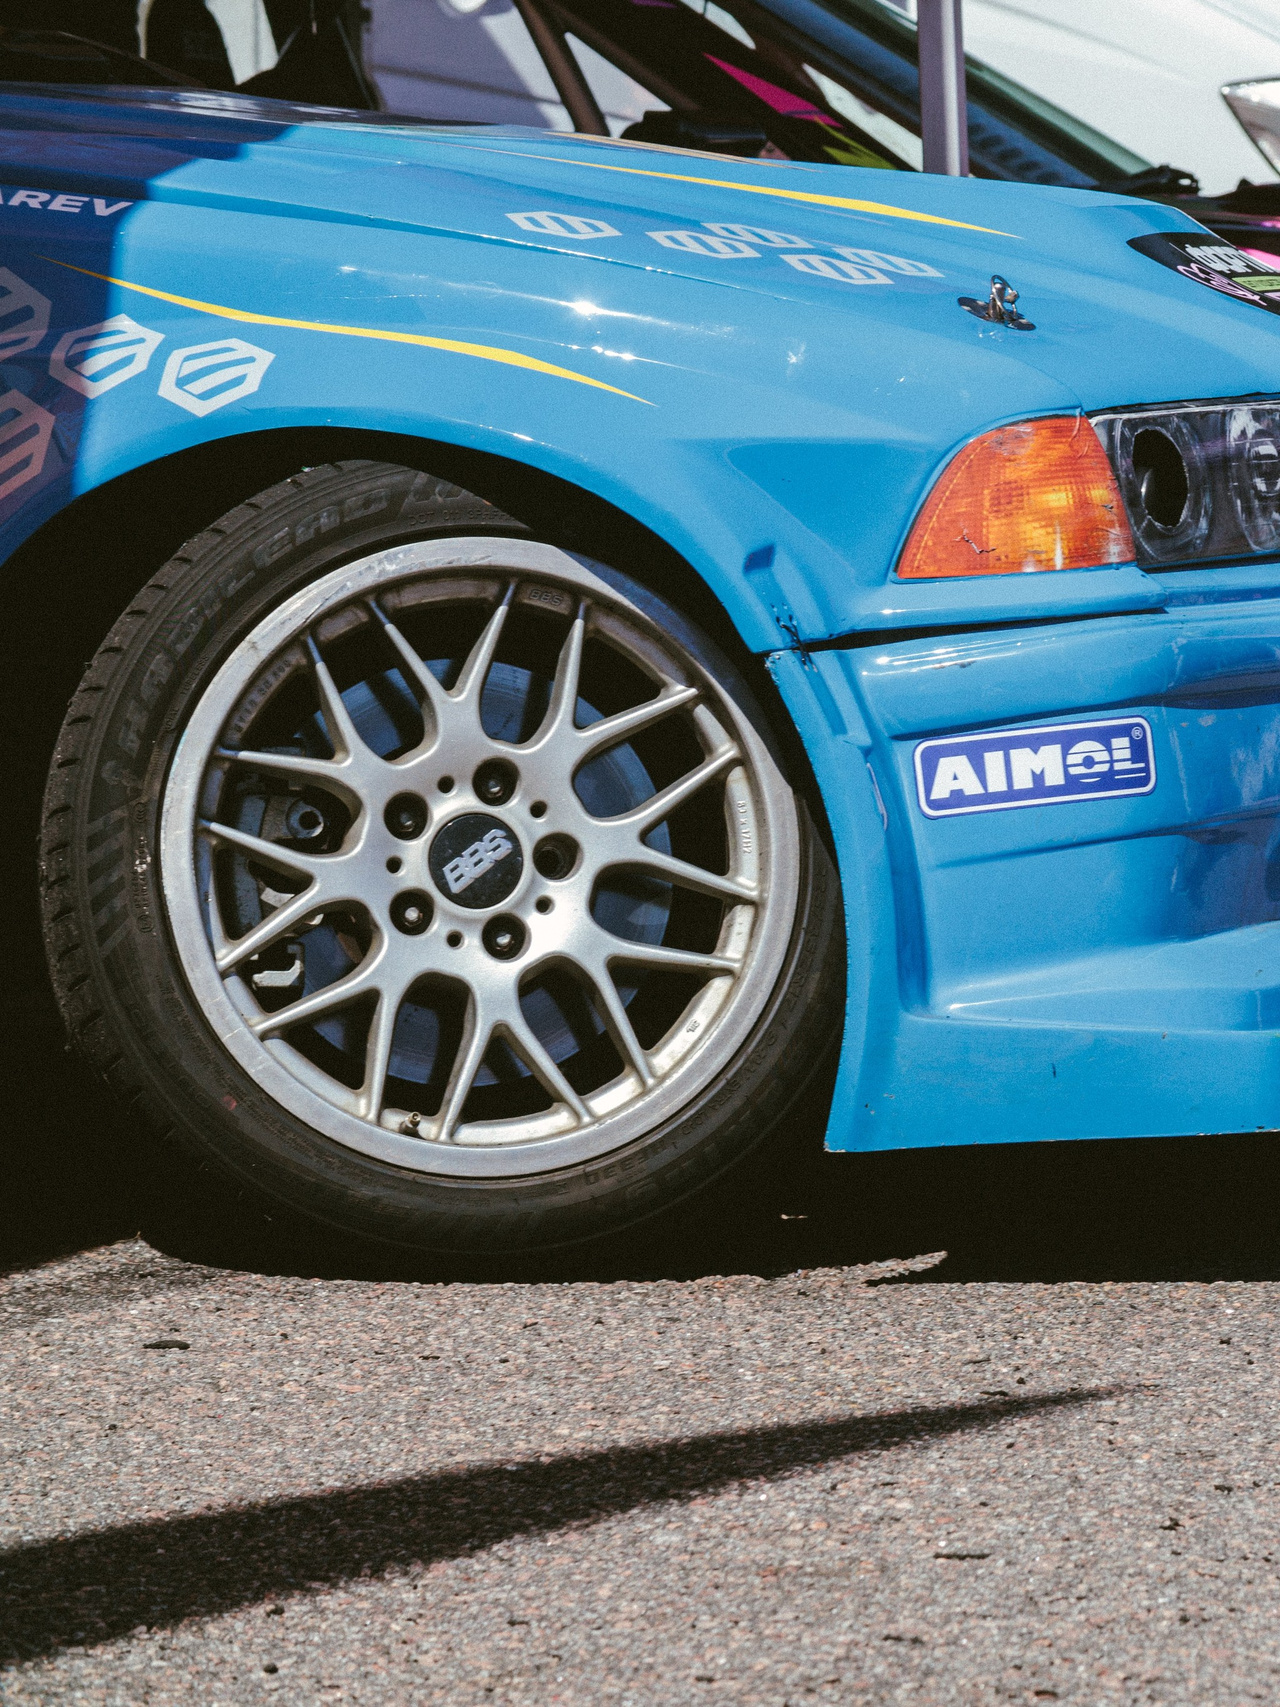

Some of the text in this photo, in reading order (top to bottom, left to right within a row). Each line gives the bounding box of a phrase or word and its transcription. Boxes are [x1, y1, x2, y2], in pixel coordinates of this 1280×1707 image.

[0, 188, 134, 217] REV
[929, 736, 1147, 801] AIMOL
[442, 828, 513, 894] BBS
